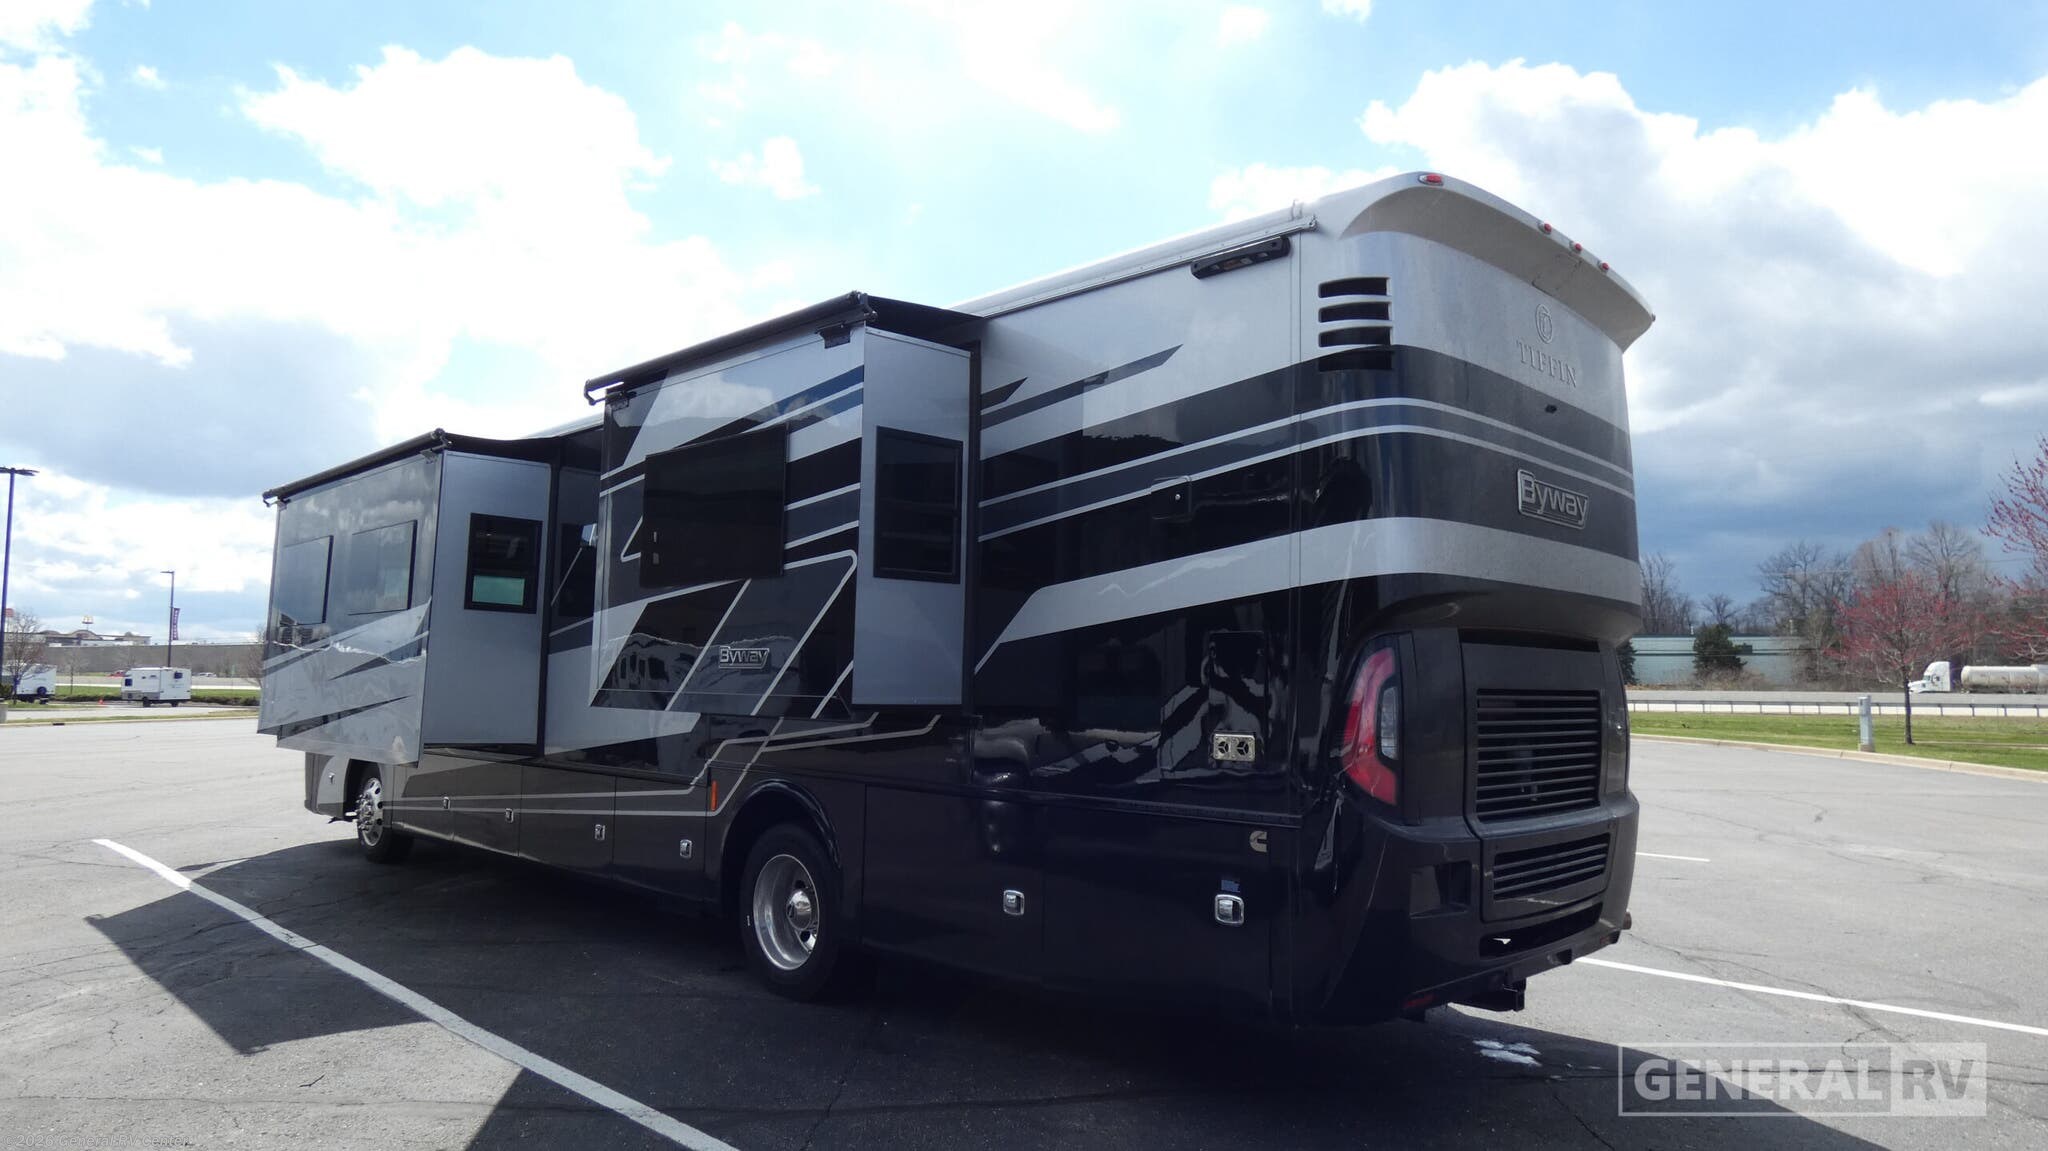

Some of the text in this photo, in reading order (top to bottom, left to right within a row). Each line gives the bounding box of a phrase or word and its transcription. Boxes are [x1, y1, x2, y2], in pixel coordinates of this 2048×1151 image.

[1516, 340, 1577, 388] TIFFIN
[1520, 472, 1588, 526] Byway
[720, 647, 769, 666] Byway
